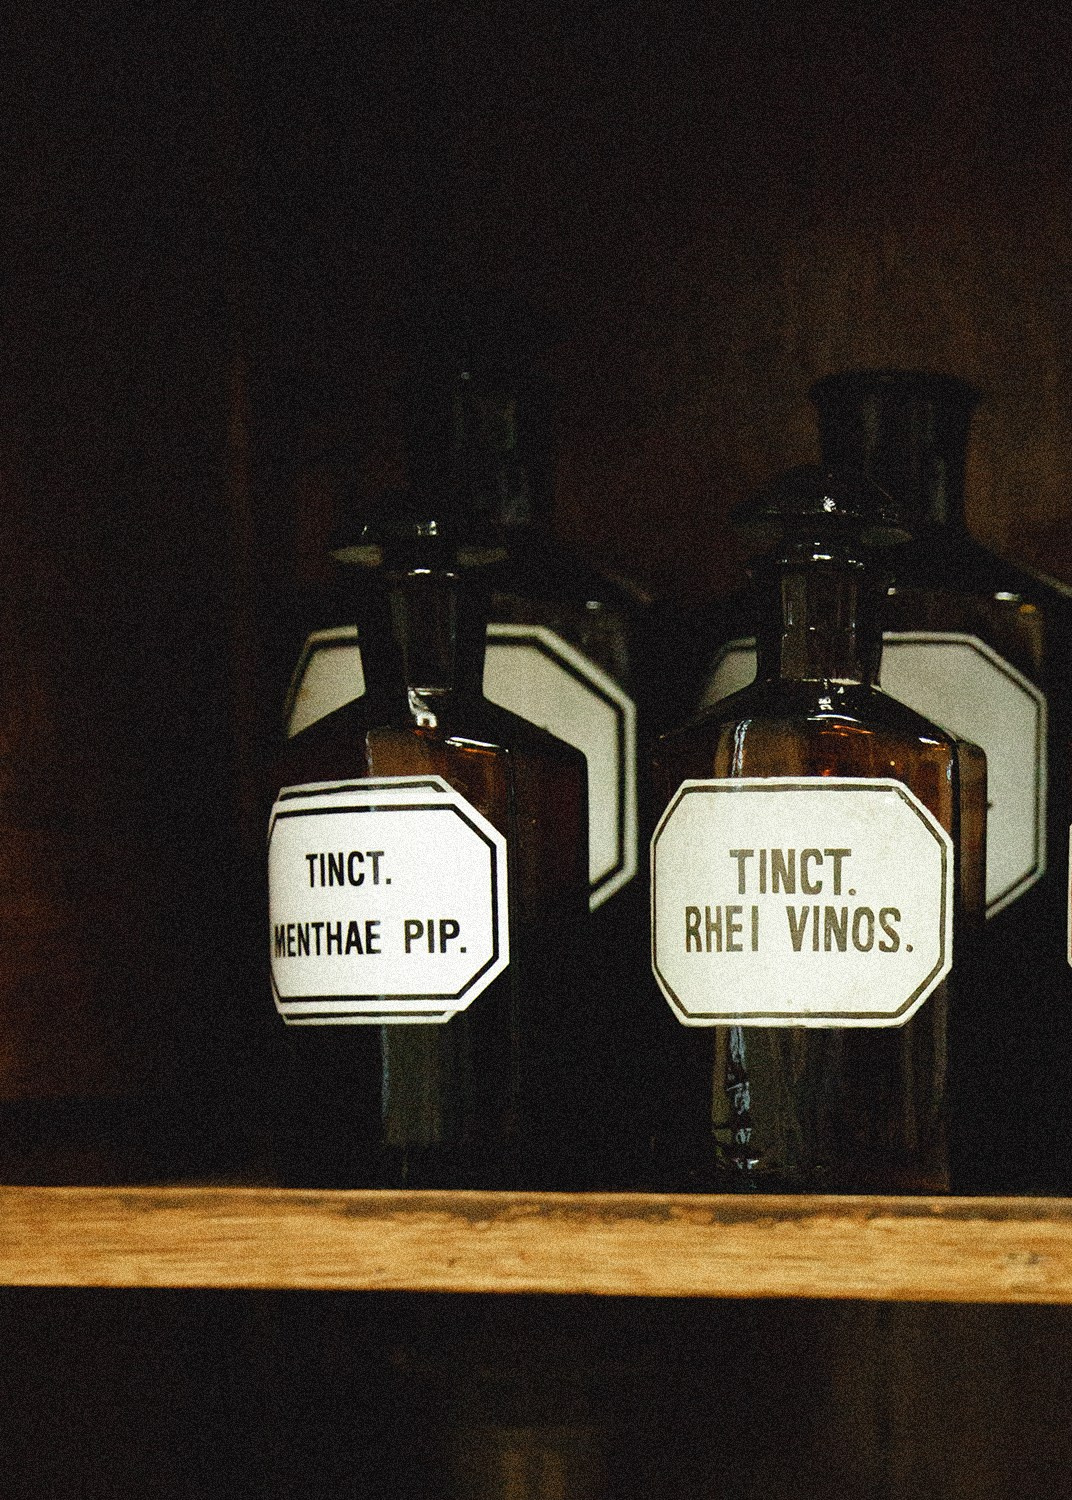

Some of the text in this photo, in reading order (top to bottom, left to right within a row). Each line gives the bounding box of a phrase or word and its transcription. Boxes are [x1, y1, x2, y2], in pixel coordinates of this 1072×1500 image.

[305, 850, 393, 888] TINCT.
[728, 847, 858, 896] TINCT.
[274, 918, 468, 958] MENTHAE PIP.
[684, 905, 914, 954] RHEI VINOS.
